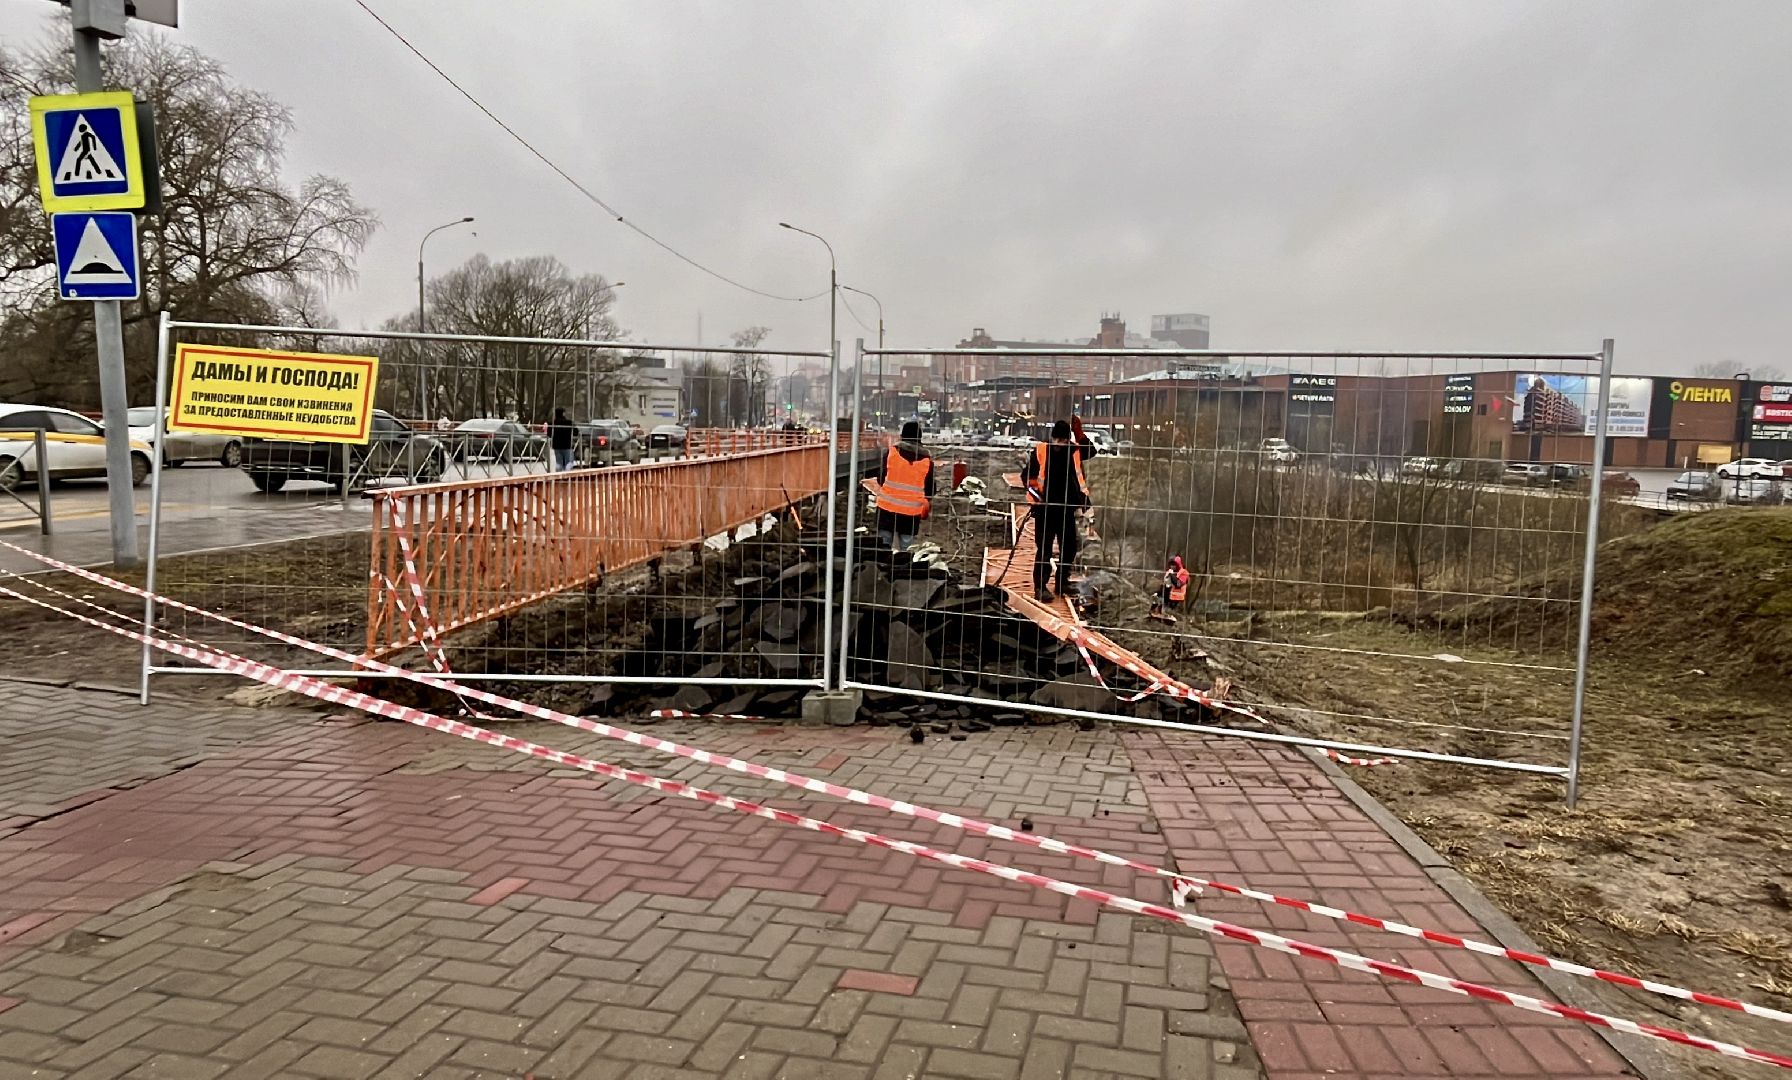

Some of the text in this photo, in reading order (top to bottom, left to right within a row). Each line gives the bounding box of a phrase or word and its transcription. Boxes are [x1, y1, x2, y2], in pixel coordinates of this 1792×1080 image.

[192, 361, 360, 391] ДАМЫ И ГОСПОДА!
[191, 391, 353, 412] ПРИНОСИМ ВАМ СВОИ ИЗВИНЕНИЯ
[1682, 386, 1732, 403] ЛЕНТА
[184, 405, 356, 426] ЗА ПРЕДОСТАВЛЕННЫЕ НЕУДОБСТВА
